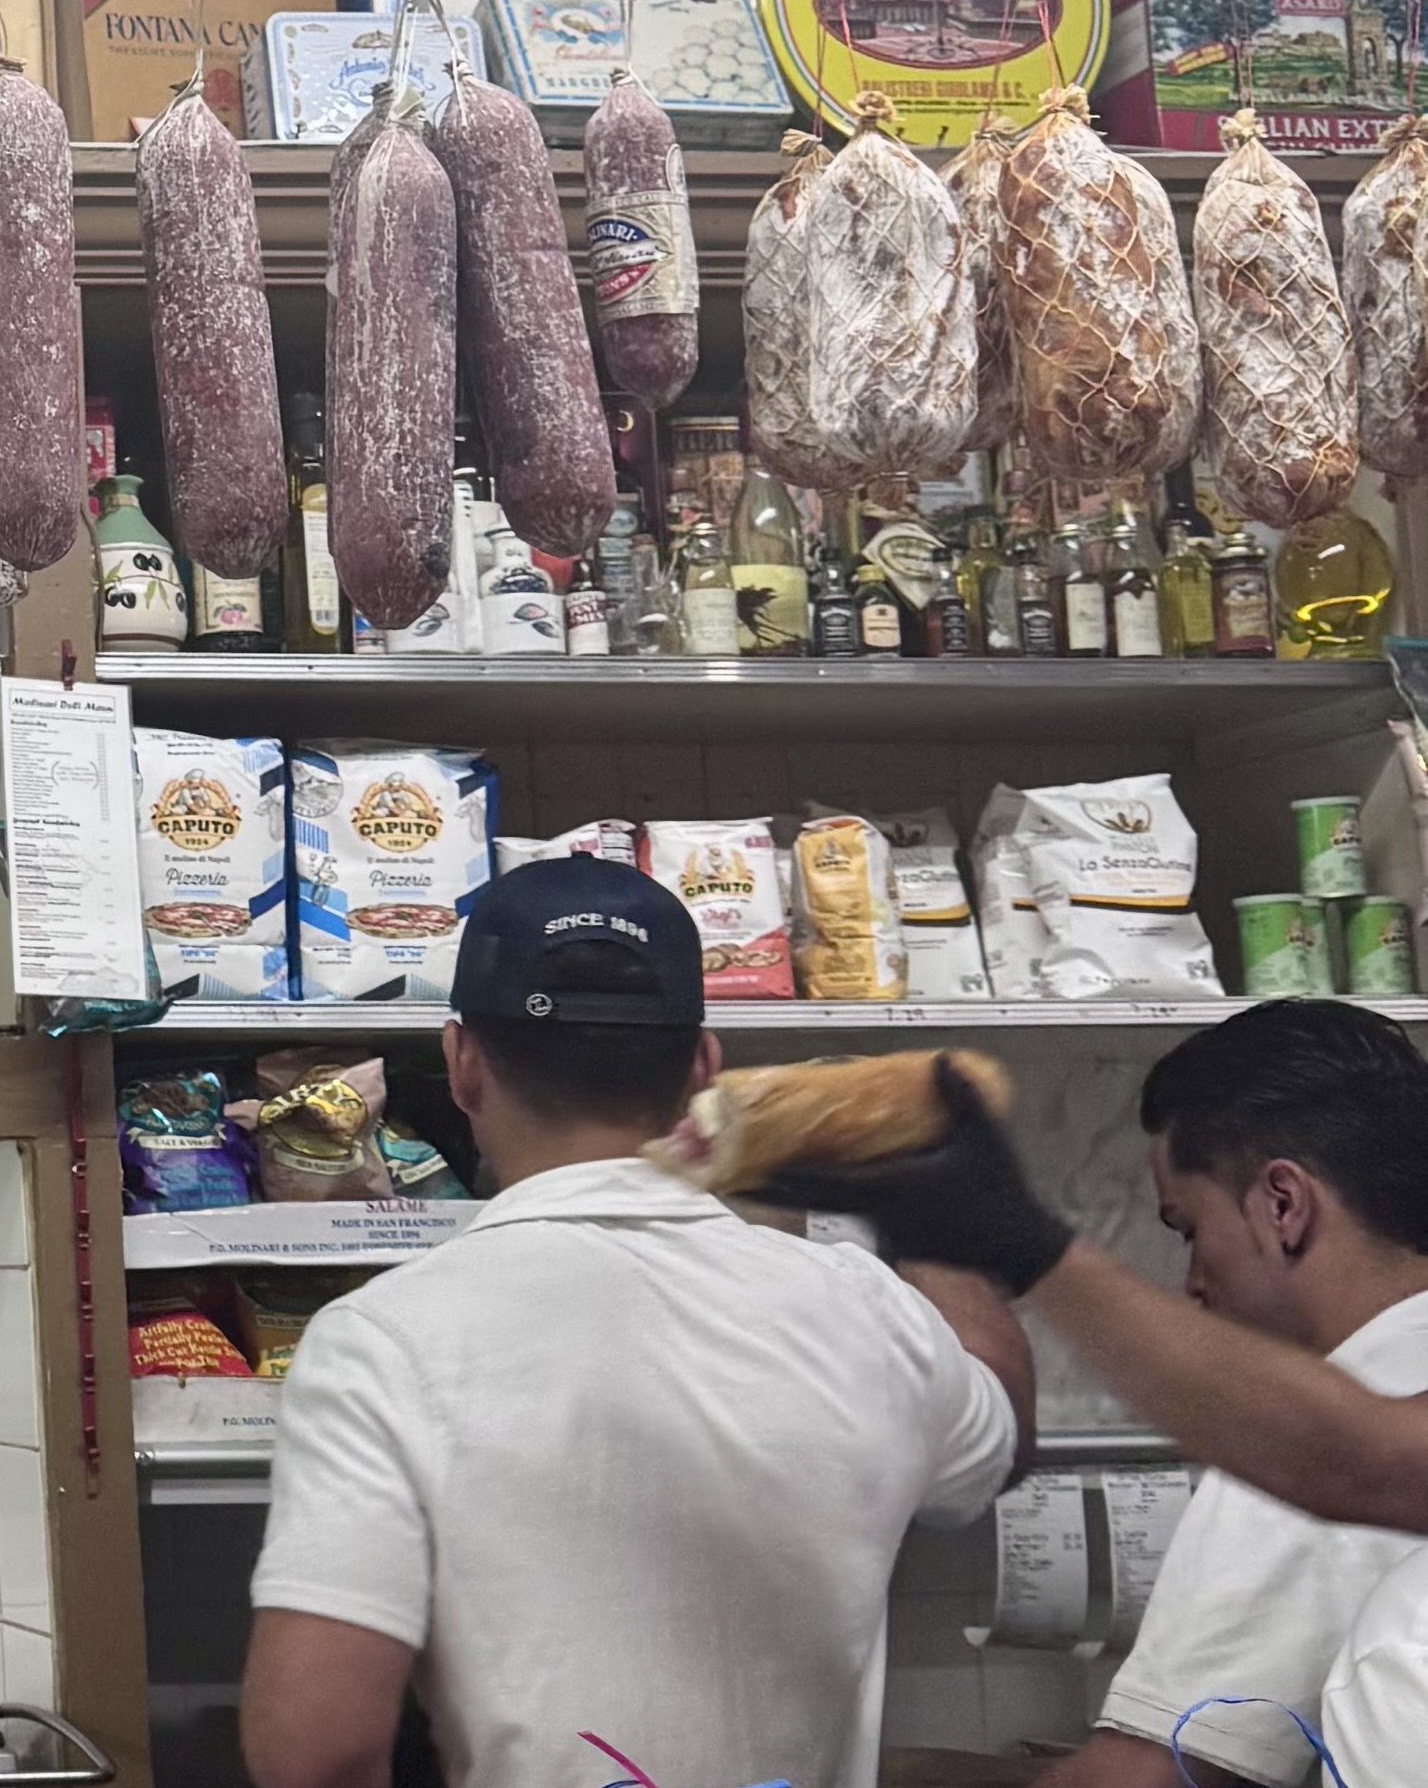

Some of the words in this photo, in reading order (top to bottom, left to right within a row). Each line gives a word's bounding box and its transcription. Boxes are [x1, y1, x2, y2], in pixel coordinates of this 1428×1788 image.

[105, 13, 212, 45] FONTANA
[157, 819, 235, 835] CAPUTO
[165, 868, 229, 888] Pizzeria
[682, 879, 755, 901] CAPUTO
[545, 913, 604, 936] SINCE
